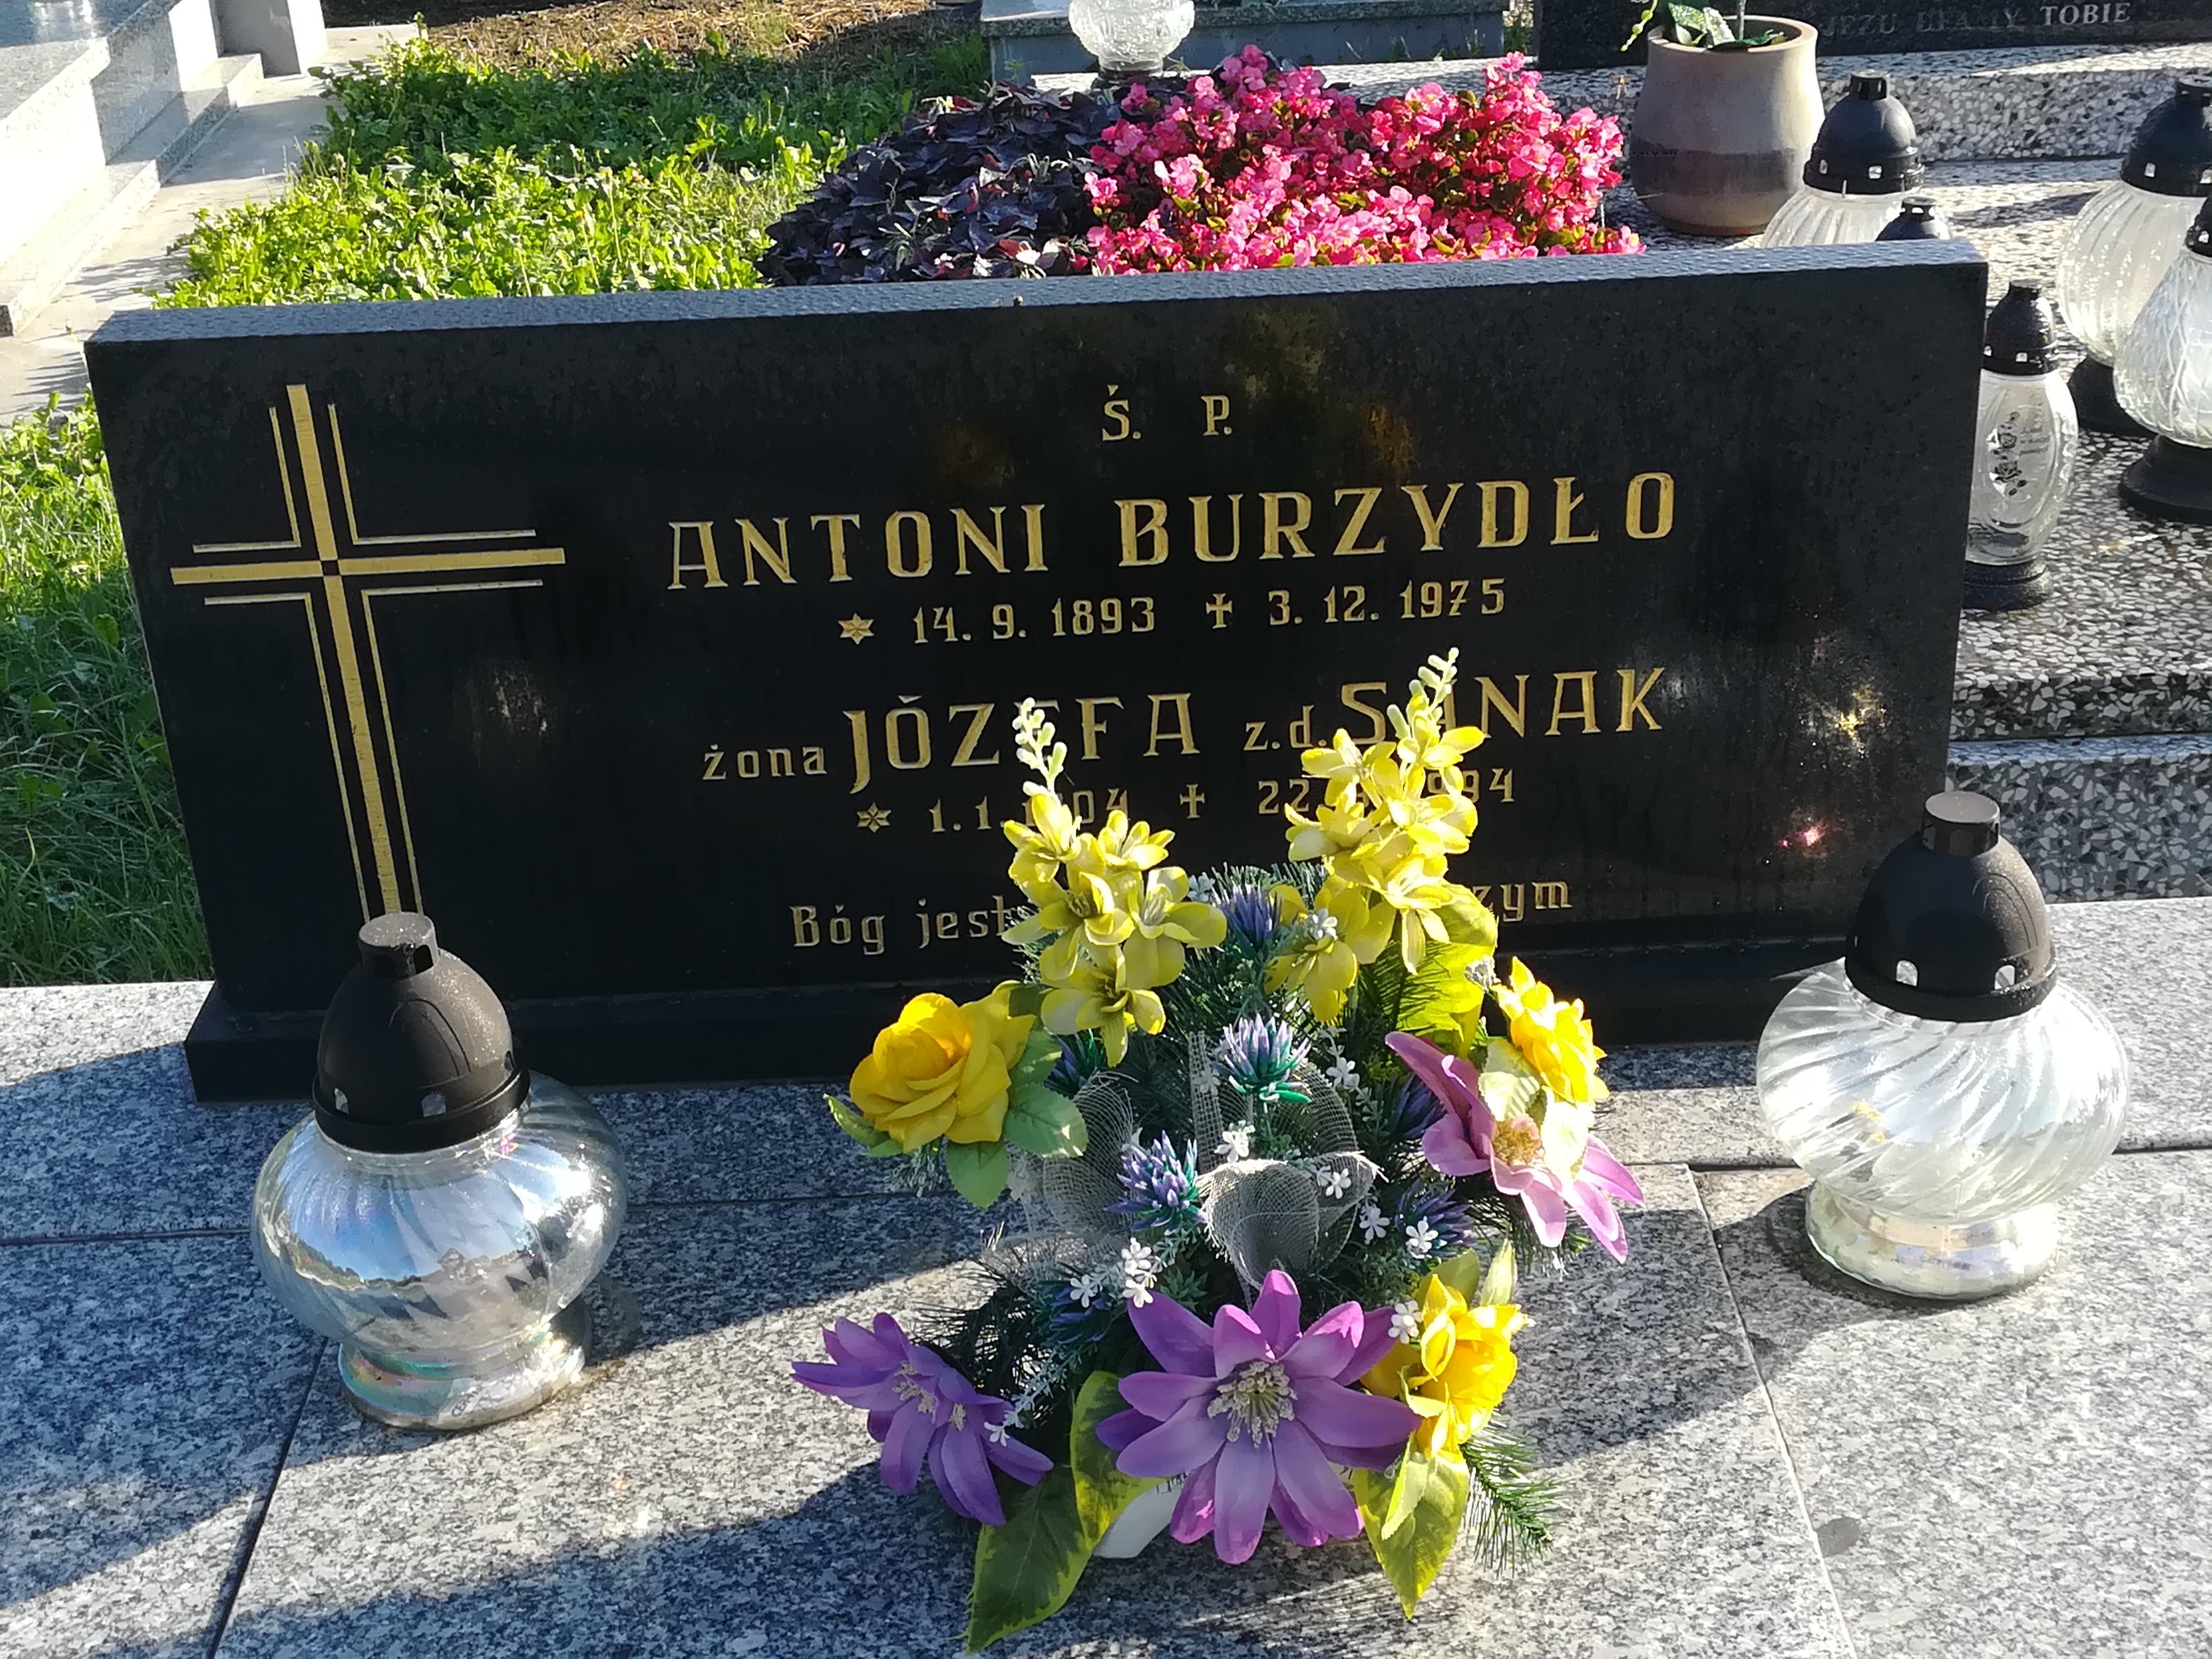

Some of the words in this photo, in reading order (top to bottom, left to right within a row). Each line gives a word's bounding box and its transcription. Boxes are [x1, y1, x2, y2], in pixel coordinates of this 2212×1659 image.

[2040, 2, 2131, 26] TOBIE
[1102, 384, 1141, 442] Ś.
[1201, 395, 1232, 436] P.
[667, 503, 1049, 590] ANTONI
[1114, 471, 1675, 567] BURZYDŁO
[913, 607, 972, 643] 14.
[992, 604, 1027, 639] 9.
[1051, 596, 1155, 637] 1893
[1268, 590, 1303, 625] 3.
[1323, 585, 1379, 623] 12.
[1401, 578, 1505, 619] 1975
[702, 744, 827, 780] żona
[789, 903, 886, 955] Bóg
[915, 895, 1010, 949] jest
